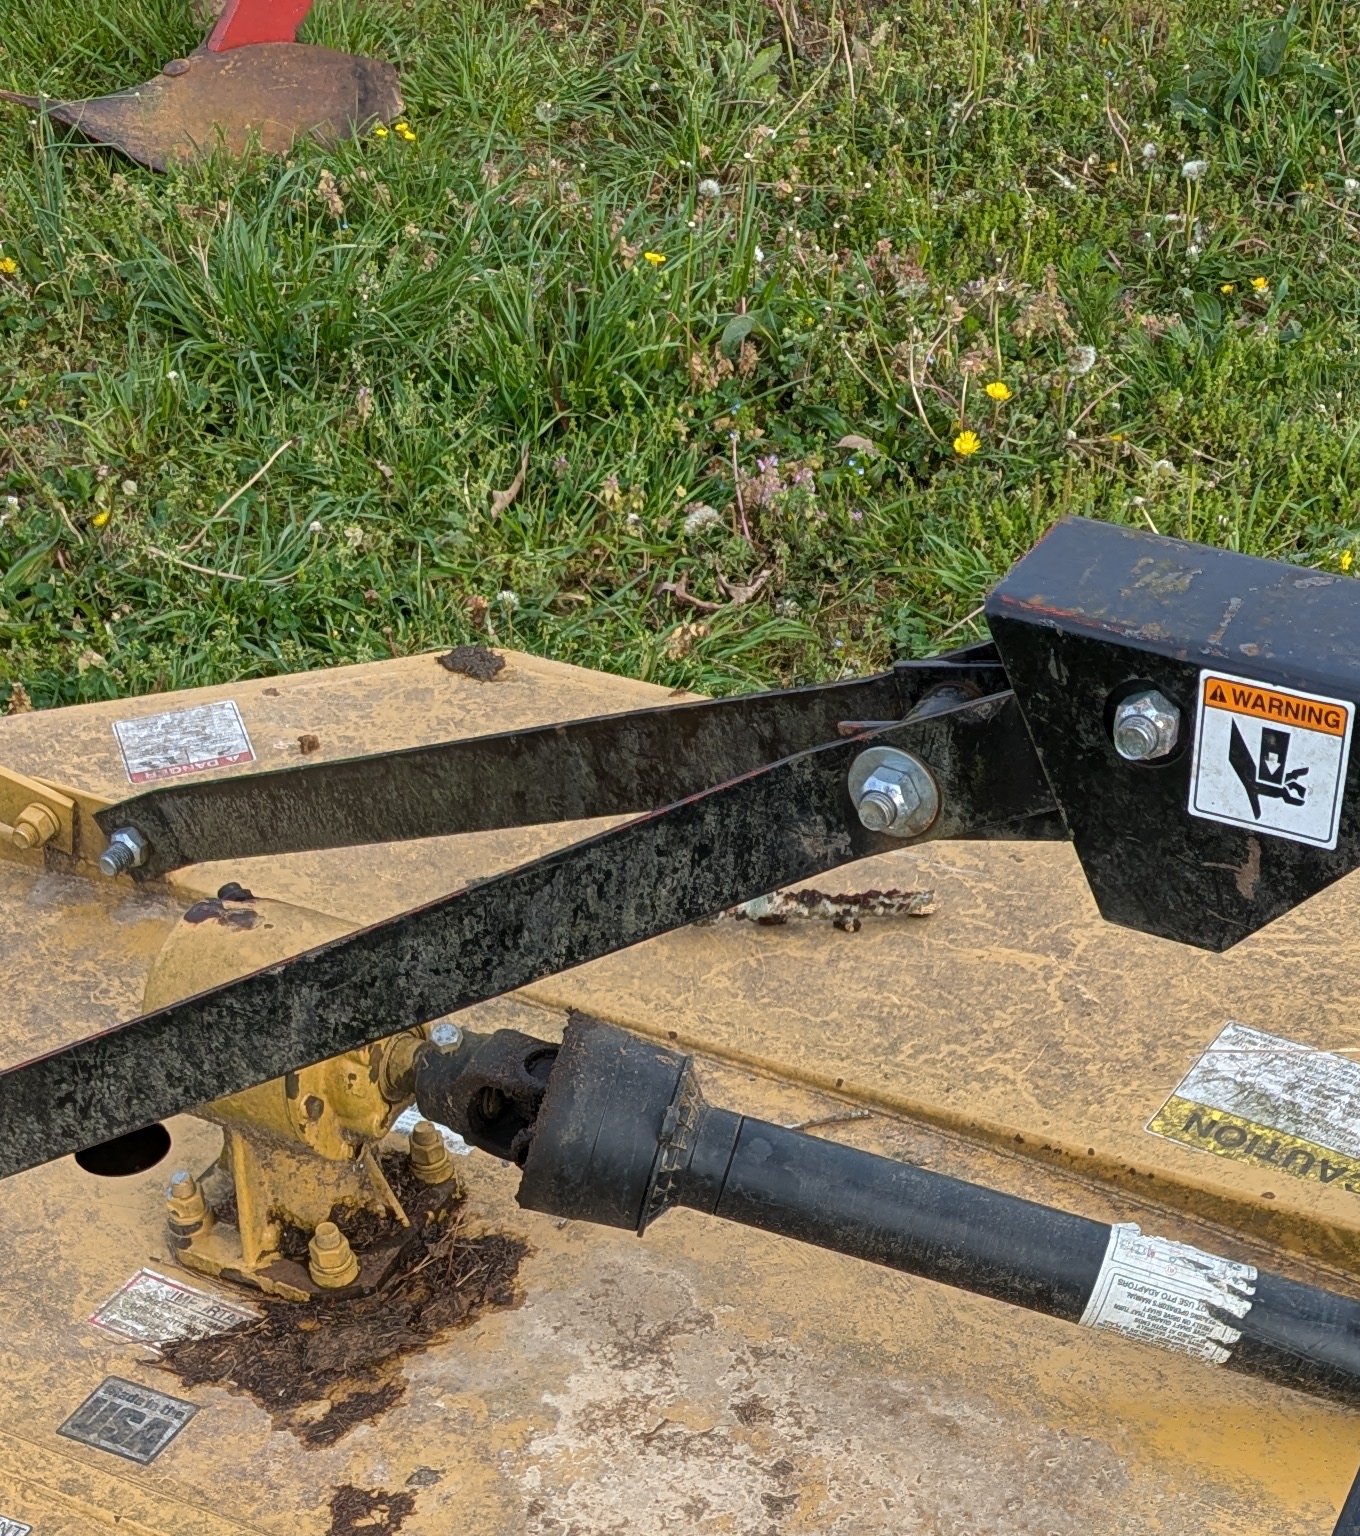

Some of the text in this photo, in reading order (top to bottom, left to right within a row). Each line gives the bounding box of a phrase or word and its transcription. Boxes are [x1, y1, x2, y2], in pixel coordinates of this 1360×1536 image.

[1234, 690, 1339, 728] WARNING
[1118, 1279, 1158, 1296] ADAPTORS
[1161, 1293, 1176, 1302] PTO
[1178, 1298, 1194, 1307] USE
[1130, 1309, 1145, 1317] THAT
[1153, 1300, 1187, 1314] OPERATOR'S
[1172, 1321, 1191, 1331] SHAFT
[104, 1384, 186, 1419] Made in the
[70, 1397, 175, 1454] USA
